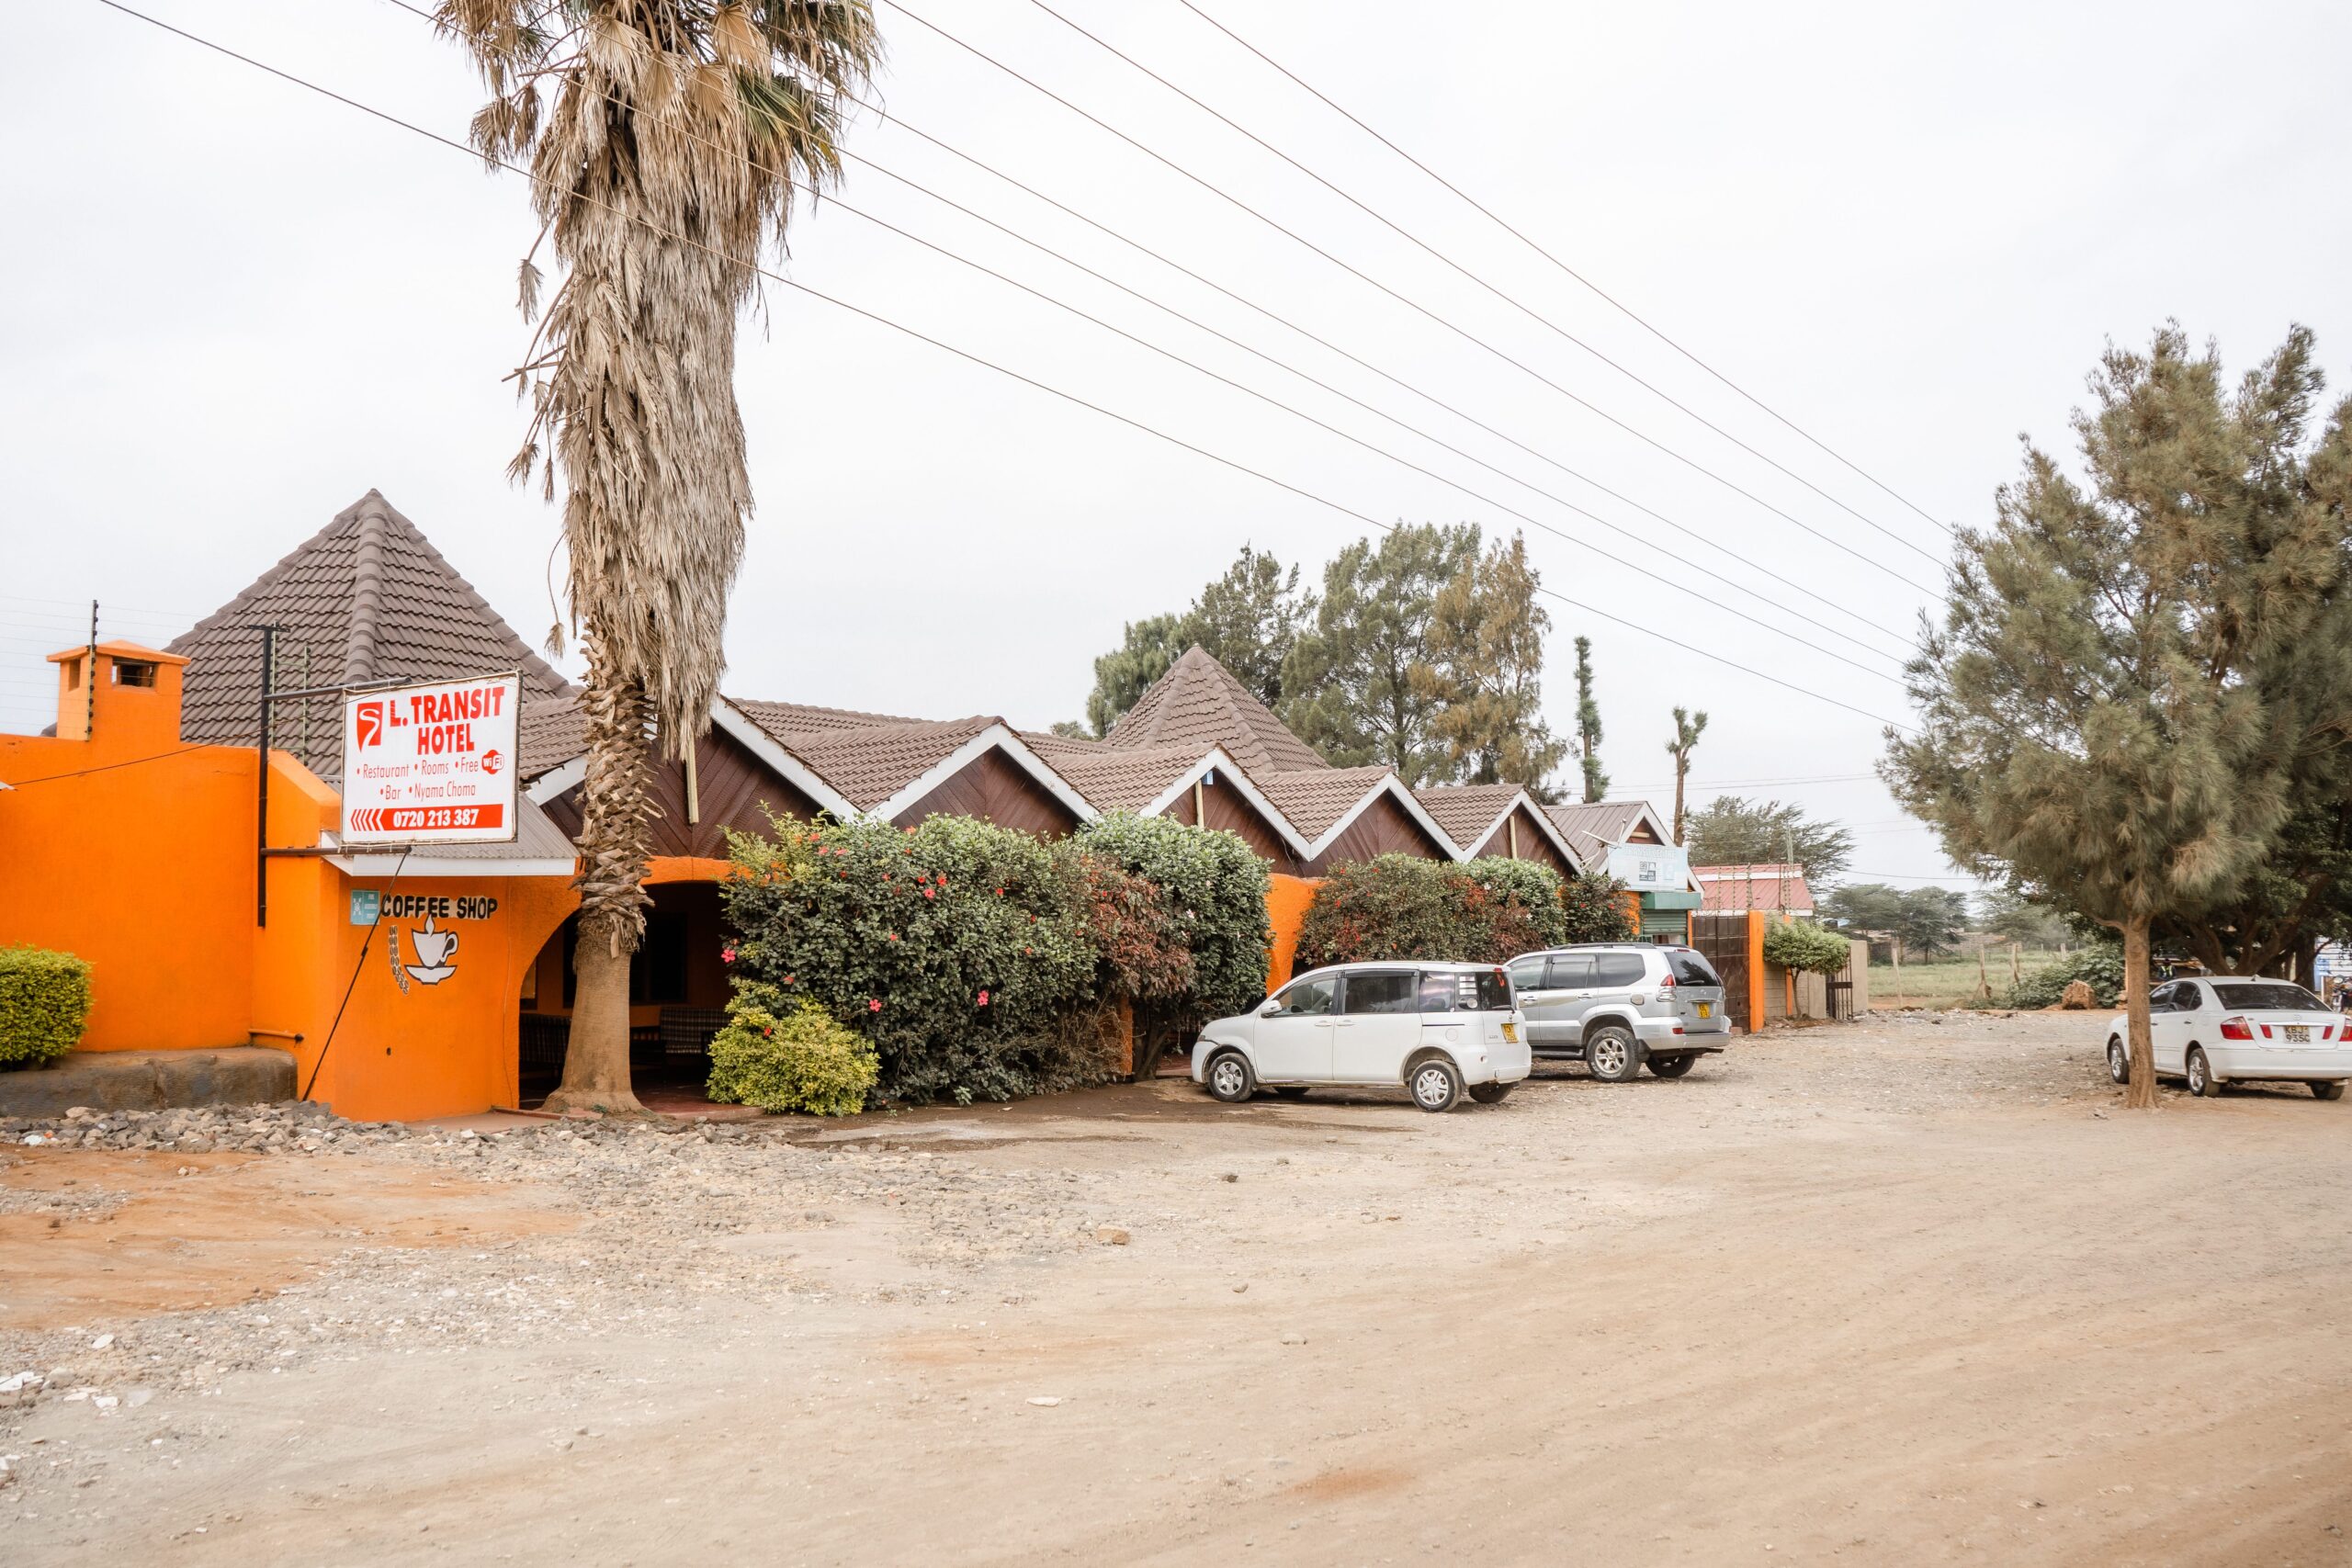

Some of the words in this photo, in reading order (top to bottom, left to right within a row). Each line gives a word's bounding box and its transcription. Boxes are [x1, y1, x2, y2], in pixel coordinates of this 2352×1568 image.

[390, 700, 408, 728] L.
[411, 686, 505, 725] TRANSIT
[417, 723, 475, 755] HOTEL
[363, 763, 410, 779] Restaurant
[422, 760, 449, 775] Rooms
[460, 756, 479, 773] Free
[385, 785, 401, 800] Bar
[414, 783, 444, 802] Nyama
[447, 781, 476, 797] Choma
[392, 810, 425, 828] 0720
[427, 809, 451, 827] 213
[453, 808, 480, 826] 387
[381, 895, 450, 918] COFFEE
[457, 897, 498, 919] SHOP
